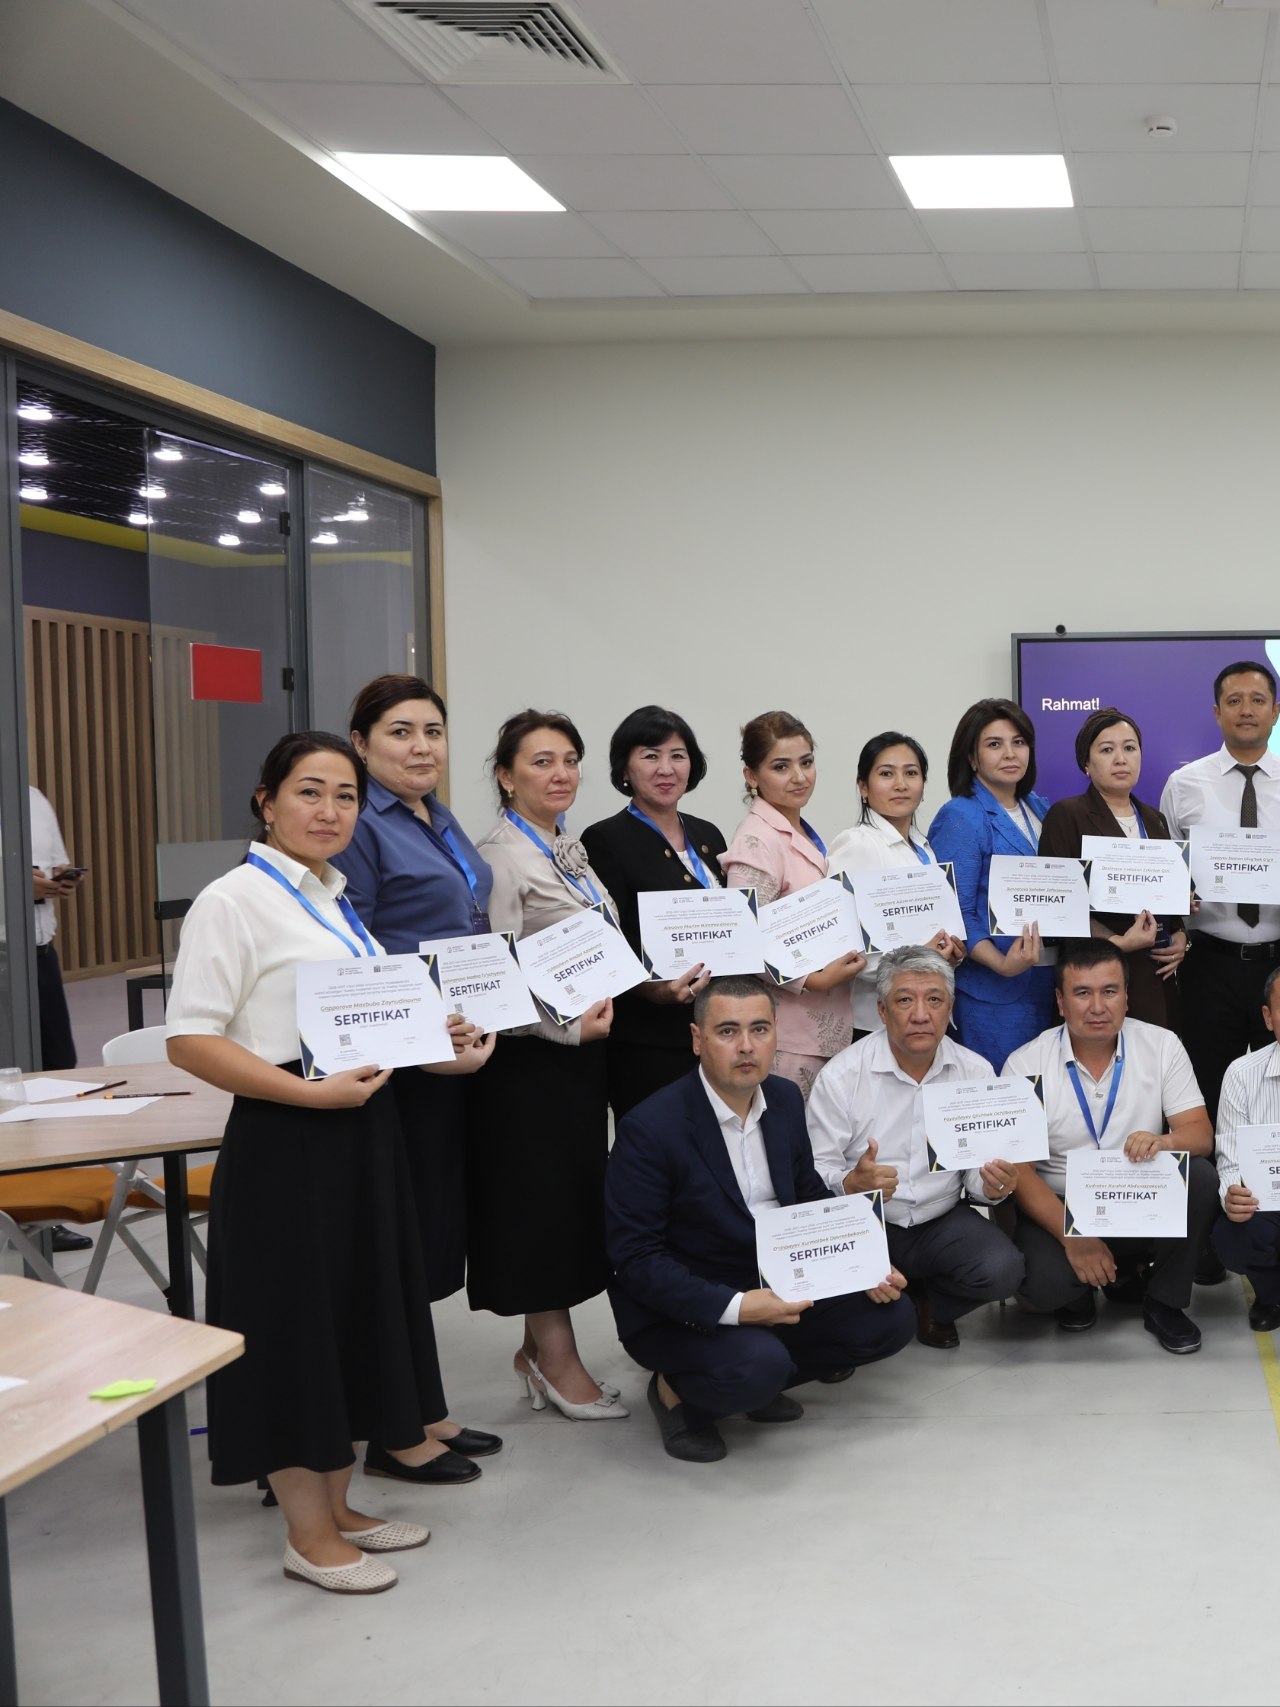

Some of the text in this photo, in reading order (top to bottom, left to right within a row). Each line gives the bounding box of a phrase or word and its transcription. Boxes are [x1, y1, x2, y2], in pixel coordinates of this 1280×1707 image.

[1042, 697, 1100, 711] Rahmat!
[1214, 862, 1269, 872] SERTIFIKAT
[1107, 873, 1164, 883] SERTIFIKAT
[1013, 894, 1066, 904] SERTIFIKAT
[882, 903, 934, 917] SERTIFIKAT
[671, 929, 732, 942] SERTIFIKAT
[783, 916, 838, 947] SERTIFIKAT
[553, 950, 605, 982] SERTIFIKAT
[449, 979, 501, 997] SERTIFIKAT
[334, 1008, 410, 1026] SERTIFIKAT
[954, 1117, 1017, 1133] SERTIFIKAT
[1094, 1191, 1158, 1200] SERTIFIKAT
[789, 1241, 856, 1262] SERTIFIKAT
